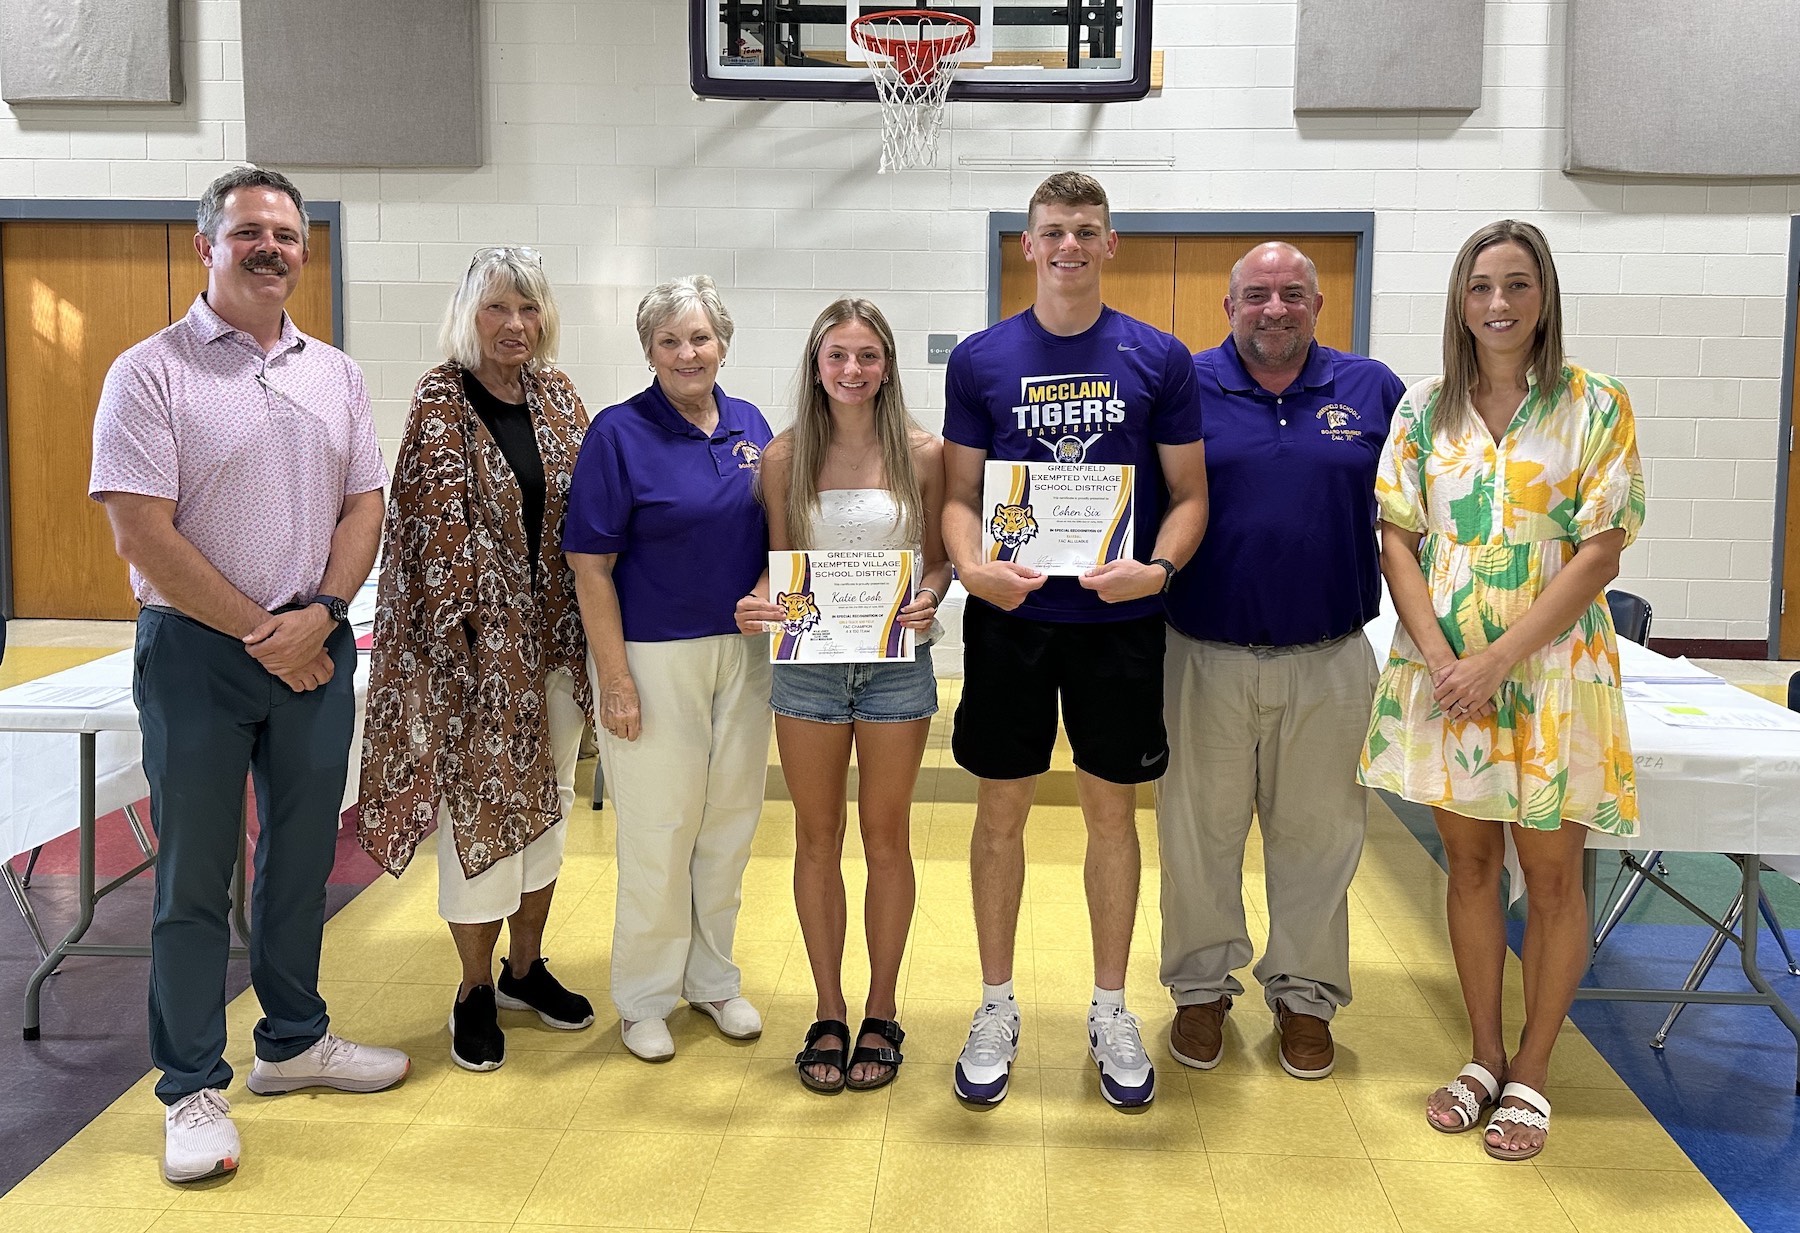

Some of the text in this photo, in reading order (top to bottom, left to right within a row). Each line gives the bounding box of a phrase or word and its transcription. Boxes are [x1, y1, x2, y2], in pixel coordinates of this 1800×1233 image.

[1028, 381, 1110, 403] MCCLAIN
[1012, 400, 1126, 430] TIGERS
[1027, 424, 1112, 437] BASEBALL
[1052, 505, 1101, 517] Cohen Six
[832, 591, 882, 603] Katie Cook
